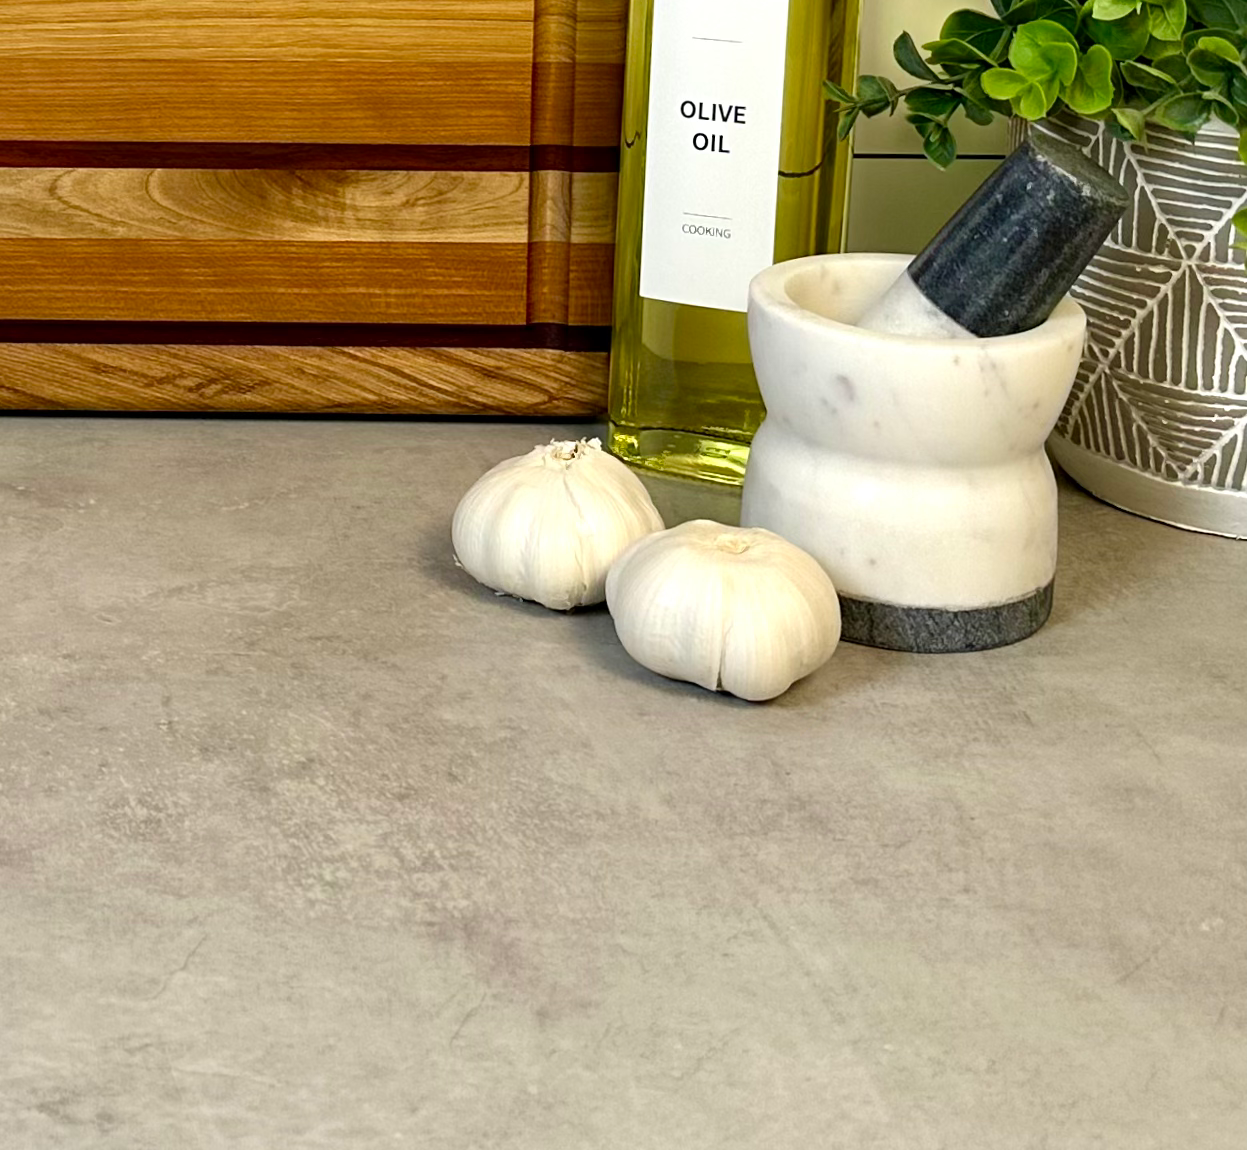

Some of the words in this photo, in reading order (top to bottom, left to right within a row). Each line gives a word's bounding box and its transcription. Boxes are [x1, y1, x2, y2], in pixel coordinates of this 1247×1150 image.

[680, 100, 746, 124] OLIVE
[692, 132, 730, 154] OIL
[681, 223, 732, 239] COOKING
